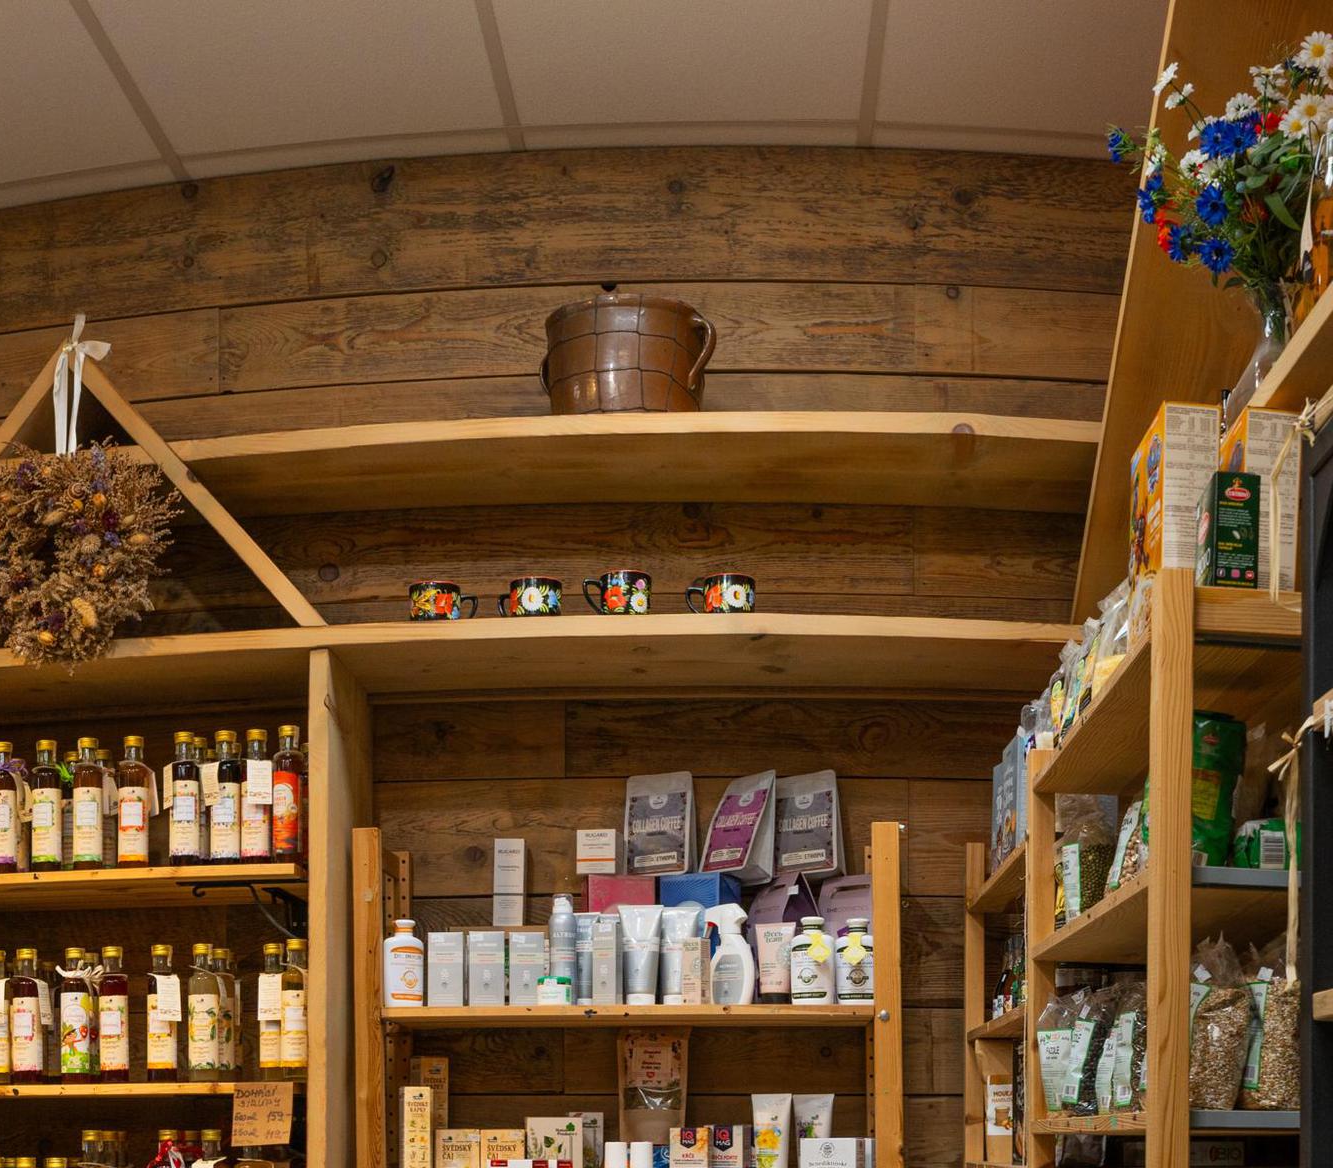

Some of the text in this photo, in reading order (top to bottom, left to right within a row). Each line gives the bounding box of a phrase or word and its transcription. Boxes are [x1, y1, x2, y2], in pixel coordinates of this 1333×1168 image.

[660, 815, 681, 831] COFFEE
[807, 813, 828, 829] COFFEE
[442, 1143, 472, 1152] ŠVÉDSKÝ
[487, 1143, 517, 1152] ŠVÉDSKÝ
[442, 1151, 454, 1160] ČAJ
[487, 1151, 499, 1160] ČAJ
